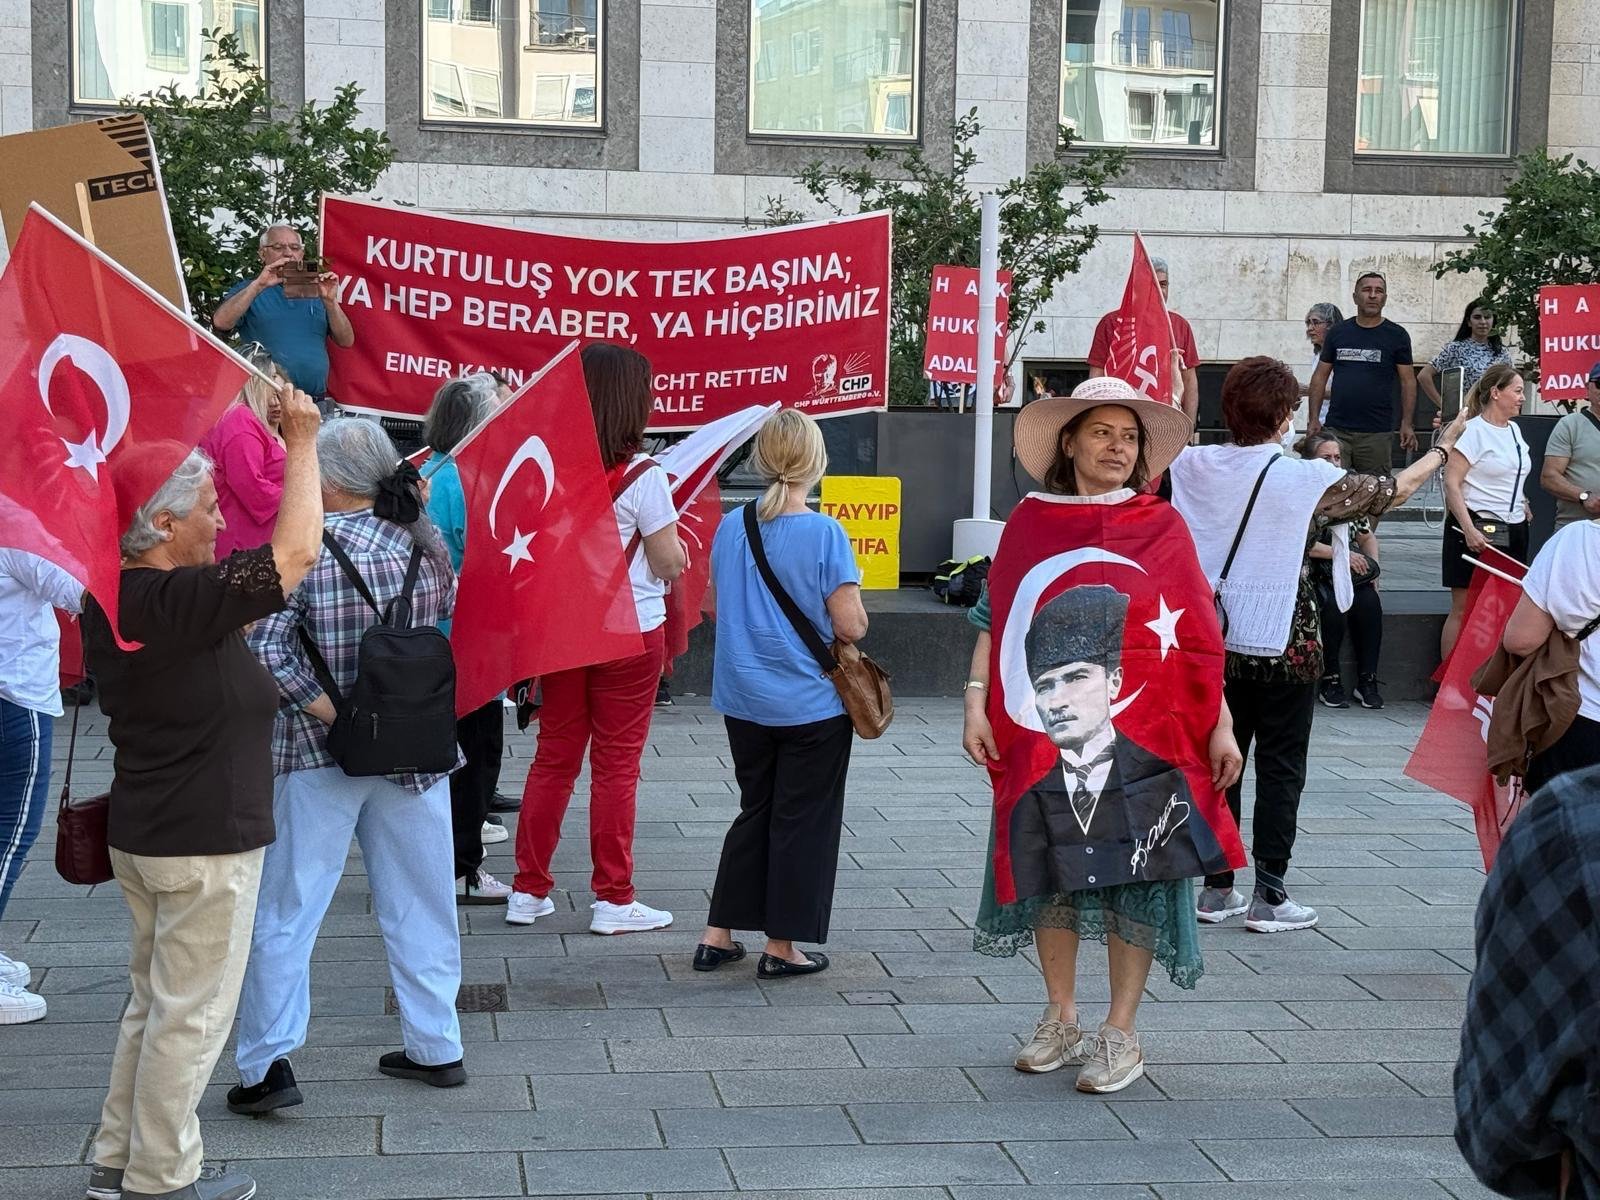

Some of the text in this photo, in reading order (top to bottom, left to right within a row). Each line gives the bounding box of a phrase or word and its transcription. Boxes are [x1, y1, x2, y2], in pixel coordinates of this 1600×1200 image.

[366, 235, 852, 299] KURTULUŞ YOK TEK BAŞINA;
[384, 283, 452, 320] HEP
[463, 296, 638, 345] BERABER,
[651, 311, 694, 339] YA
[705, 284, 880, 340] HİÇBİRİMİZ
[932, 316, 1004, 337] HUKK
[386, 352, 452, 379] EINER
[705, 365, 788, 390] RETTEN
[928, 354, 1000, 375] ADAL
[842, 377, 870, 391] CHP
[650, 395, 705, 413] ALLE
[794, 400, 810, 408] CHP
[823, 503, 898, 520] TAYYIP
